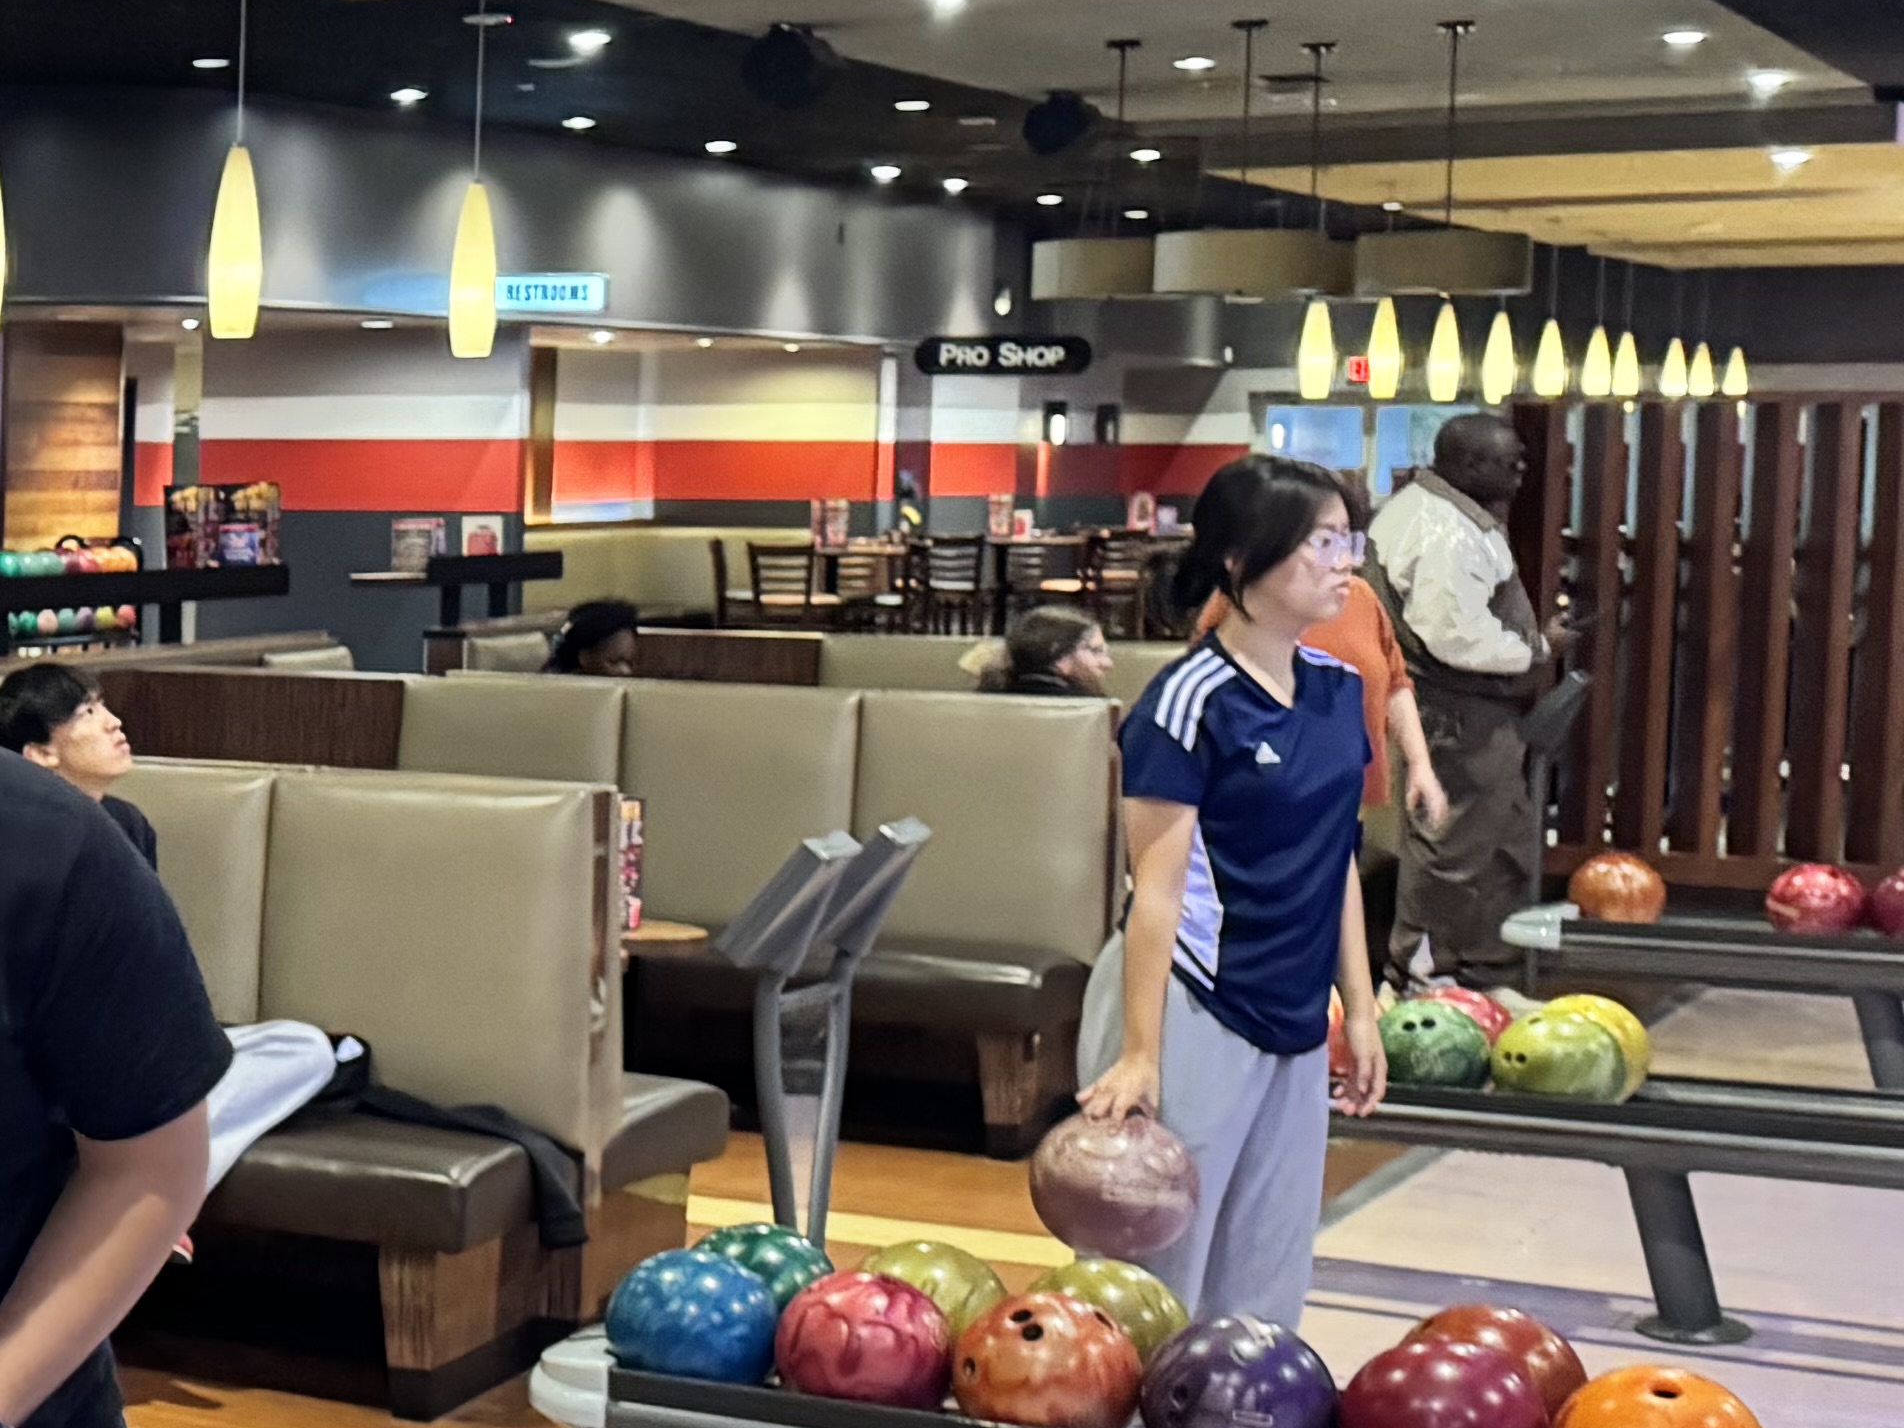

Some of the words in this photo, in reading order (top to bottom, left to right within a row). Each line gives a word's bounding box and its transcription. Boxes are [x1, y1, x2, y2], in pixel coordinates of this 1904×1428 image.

[506, 284, 588, 301] RESTROOMS
[939, 342, 990, 368] PRO
[998, 341, 1066, 368] SHOP
